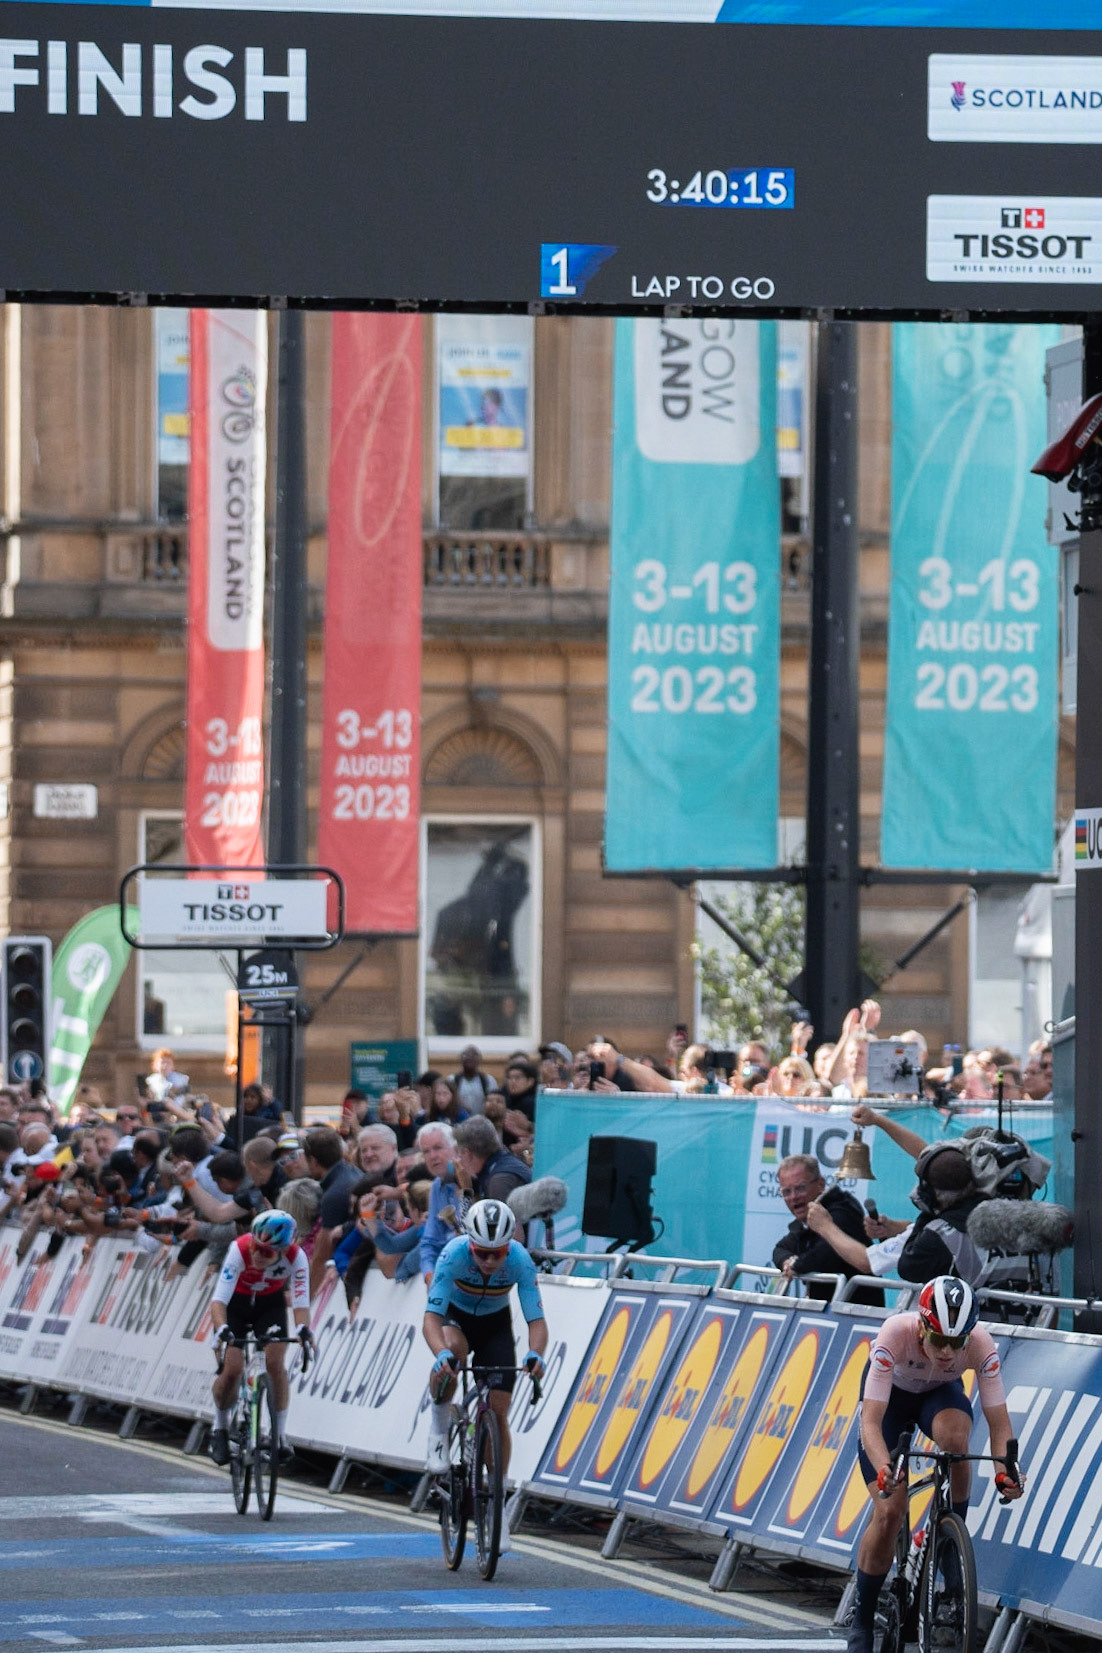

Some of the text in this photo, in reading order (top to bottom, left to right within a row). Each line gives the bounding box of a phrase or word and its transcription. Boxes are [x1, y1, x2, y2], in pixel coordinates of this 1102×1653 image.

[0, 38, 307, 121] FINISH
[972, 89, 1102, 108] SCOTLAND
[646, 168, 788, 205] 3:40:15
[954, 234, 1092, 259] TISSOT
[549, 248, 775, 300] 1 LAP TO GO
[660, 318, 693, 421] AND
[226, 457, 245, 621] SCOTLAND
[633, 558, 757, 613] 3-13
[918, 557, 1040, 611] 3-13
[632, 623, 757, 655] AUGUST
[917, 621, 1040, 652] AUGUST
[631, 665, 757, 714] 2023
[915, 663, 1039, 712] 2023
[336, 709, 412, 748] 3-13
[204, 761, 260, 785] AUGUST
[335, 754, 411, 778] AUGUST
[202, 791, 259, 828] 2023
[333, 784, 411, 820] 2023
[183, 904, 283, 921] TISSOT
[781, 1125, 849, 1168] UC
[298, 1314, 416, 1409] SCOTLAND
